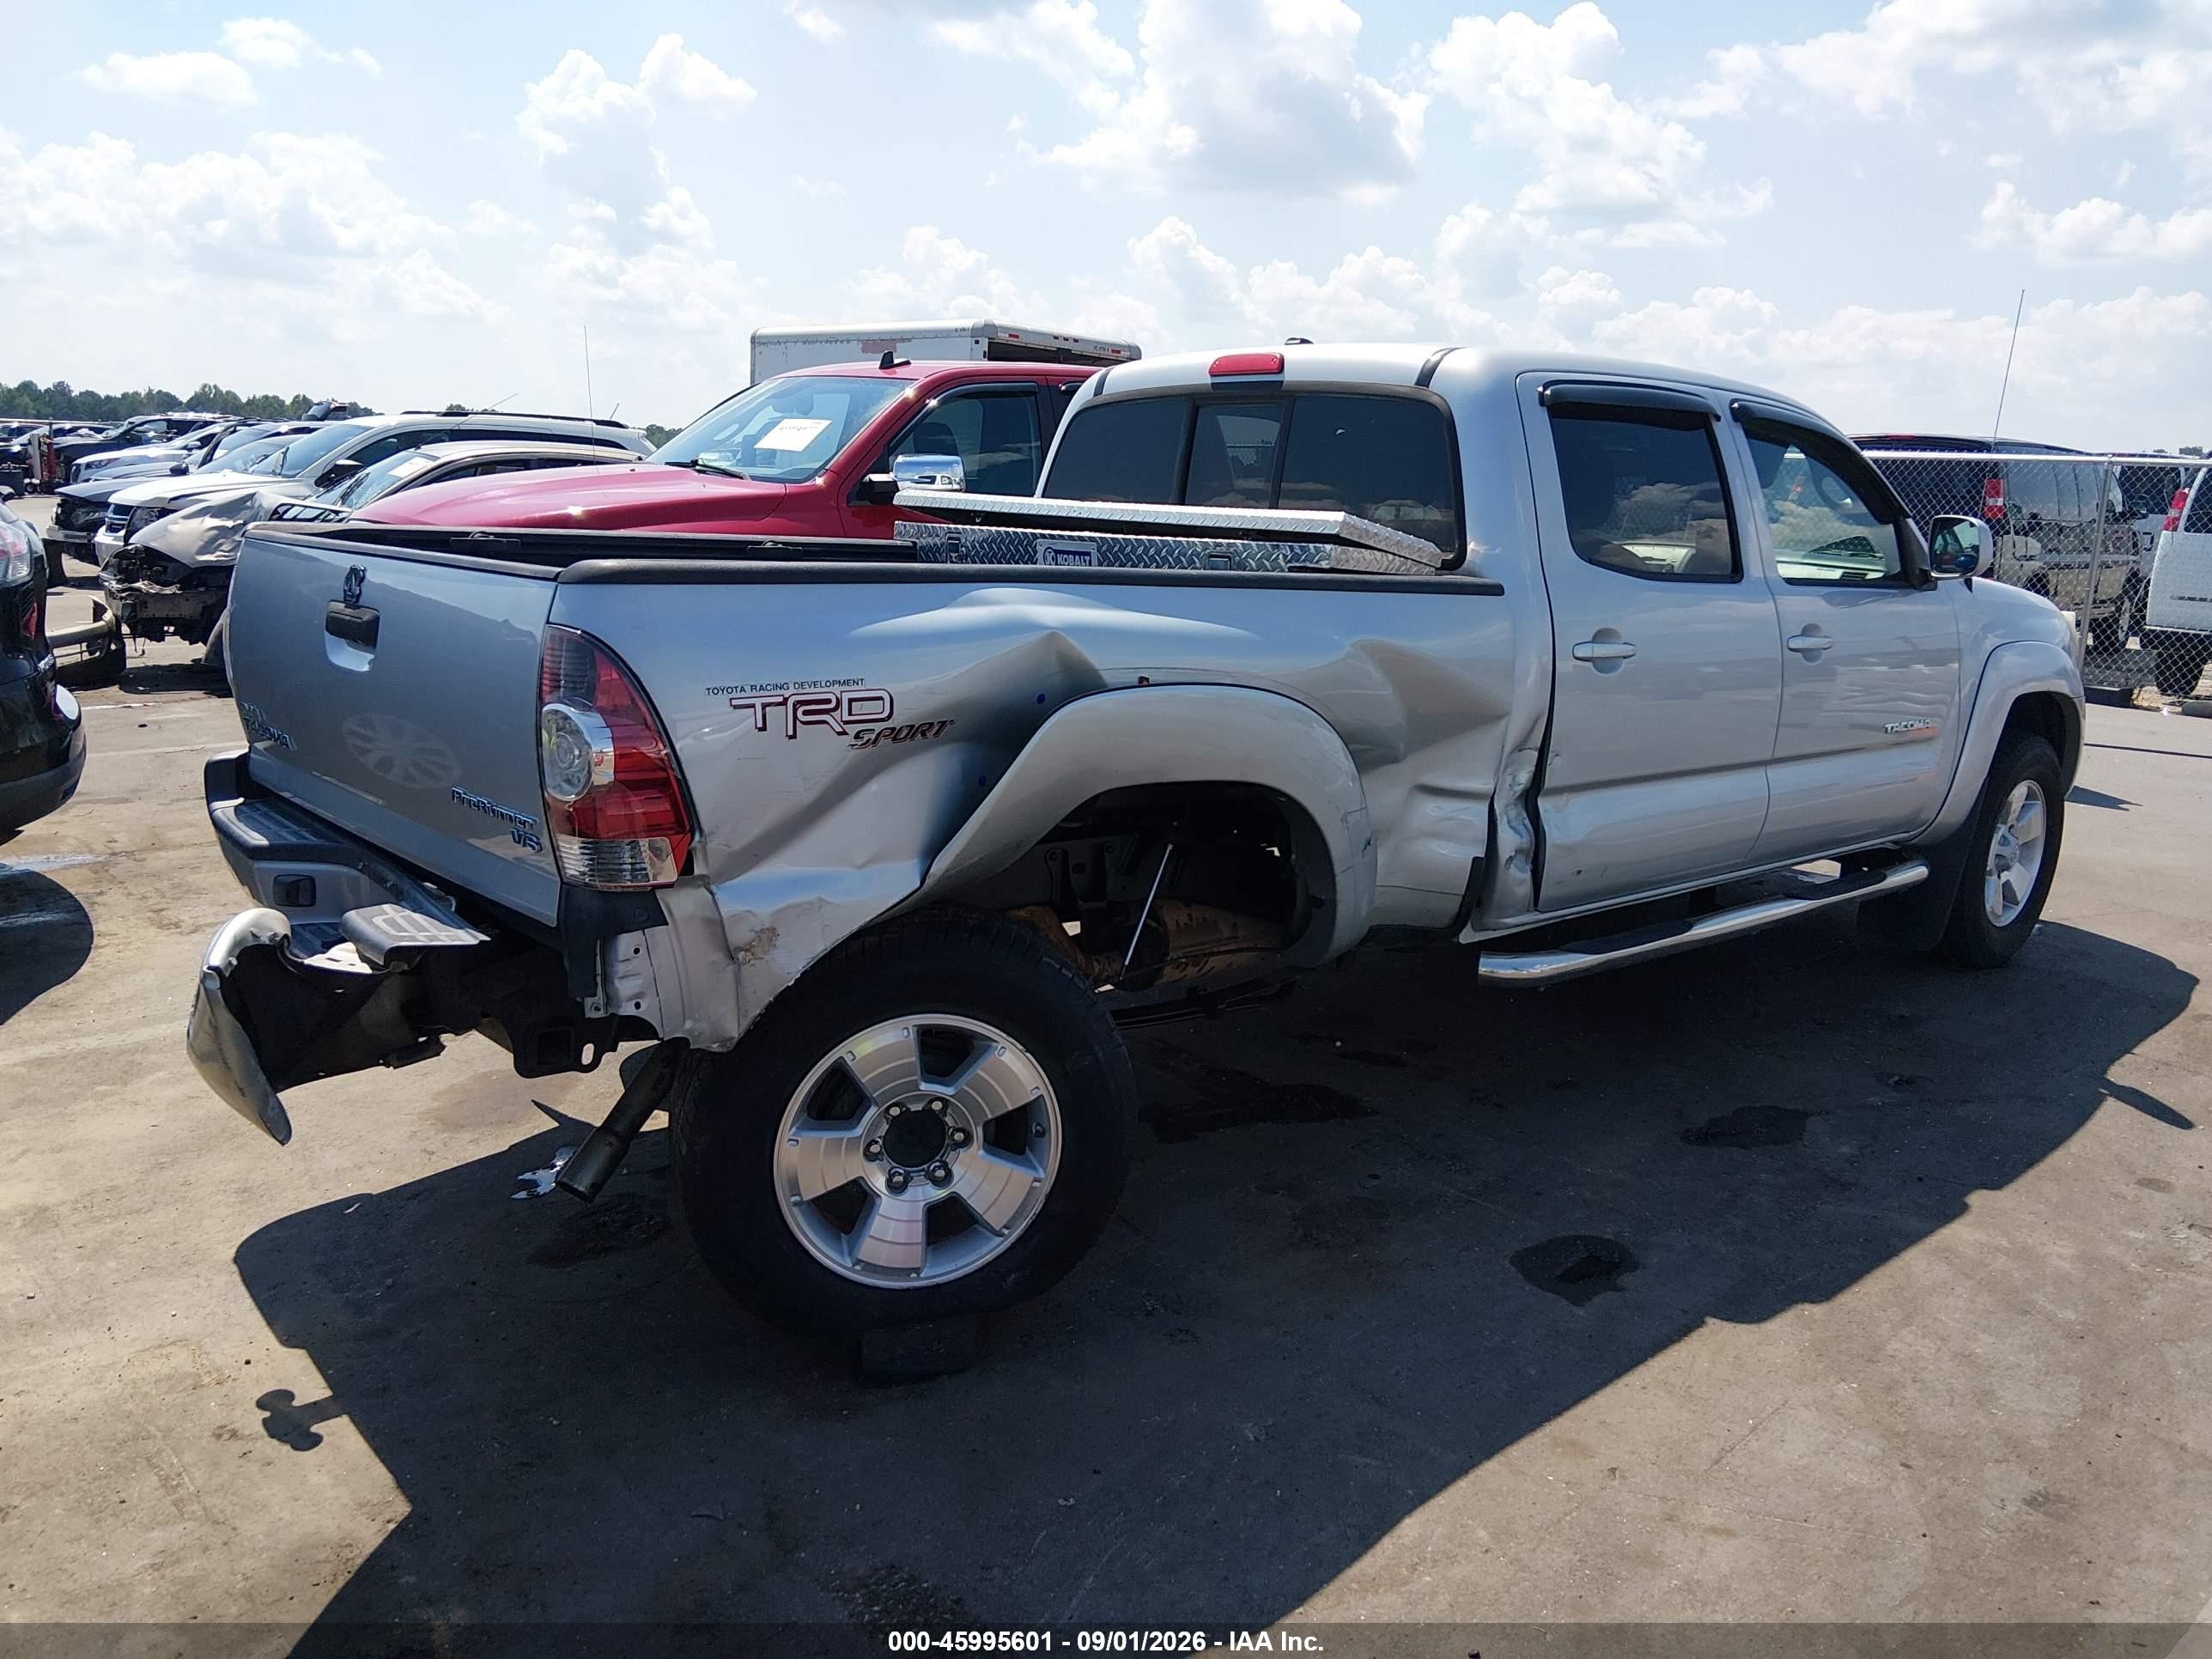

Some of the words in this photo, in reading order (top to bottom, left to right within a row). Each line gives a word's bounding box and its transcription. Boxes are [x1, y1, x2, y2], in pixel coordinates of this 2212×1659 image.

[1057, 553, 1091, 566] KOBALT
[705, 687, 747, 696] TOYOTA
[750, 682, 790, 693] RACING
[793, 678, 866, 690] DEVELOPMENT
[729, 688, 894, 740] TRD
[847, 720, 951, 750] SPORT
[450, 785, 538, 830] PreRunner
[509, 827, 544, 854] V6
